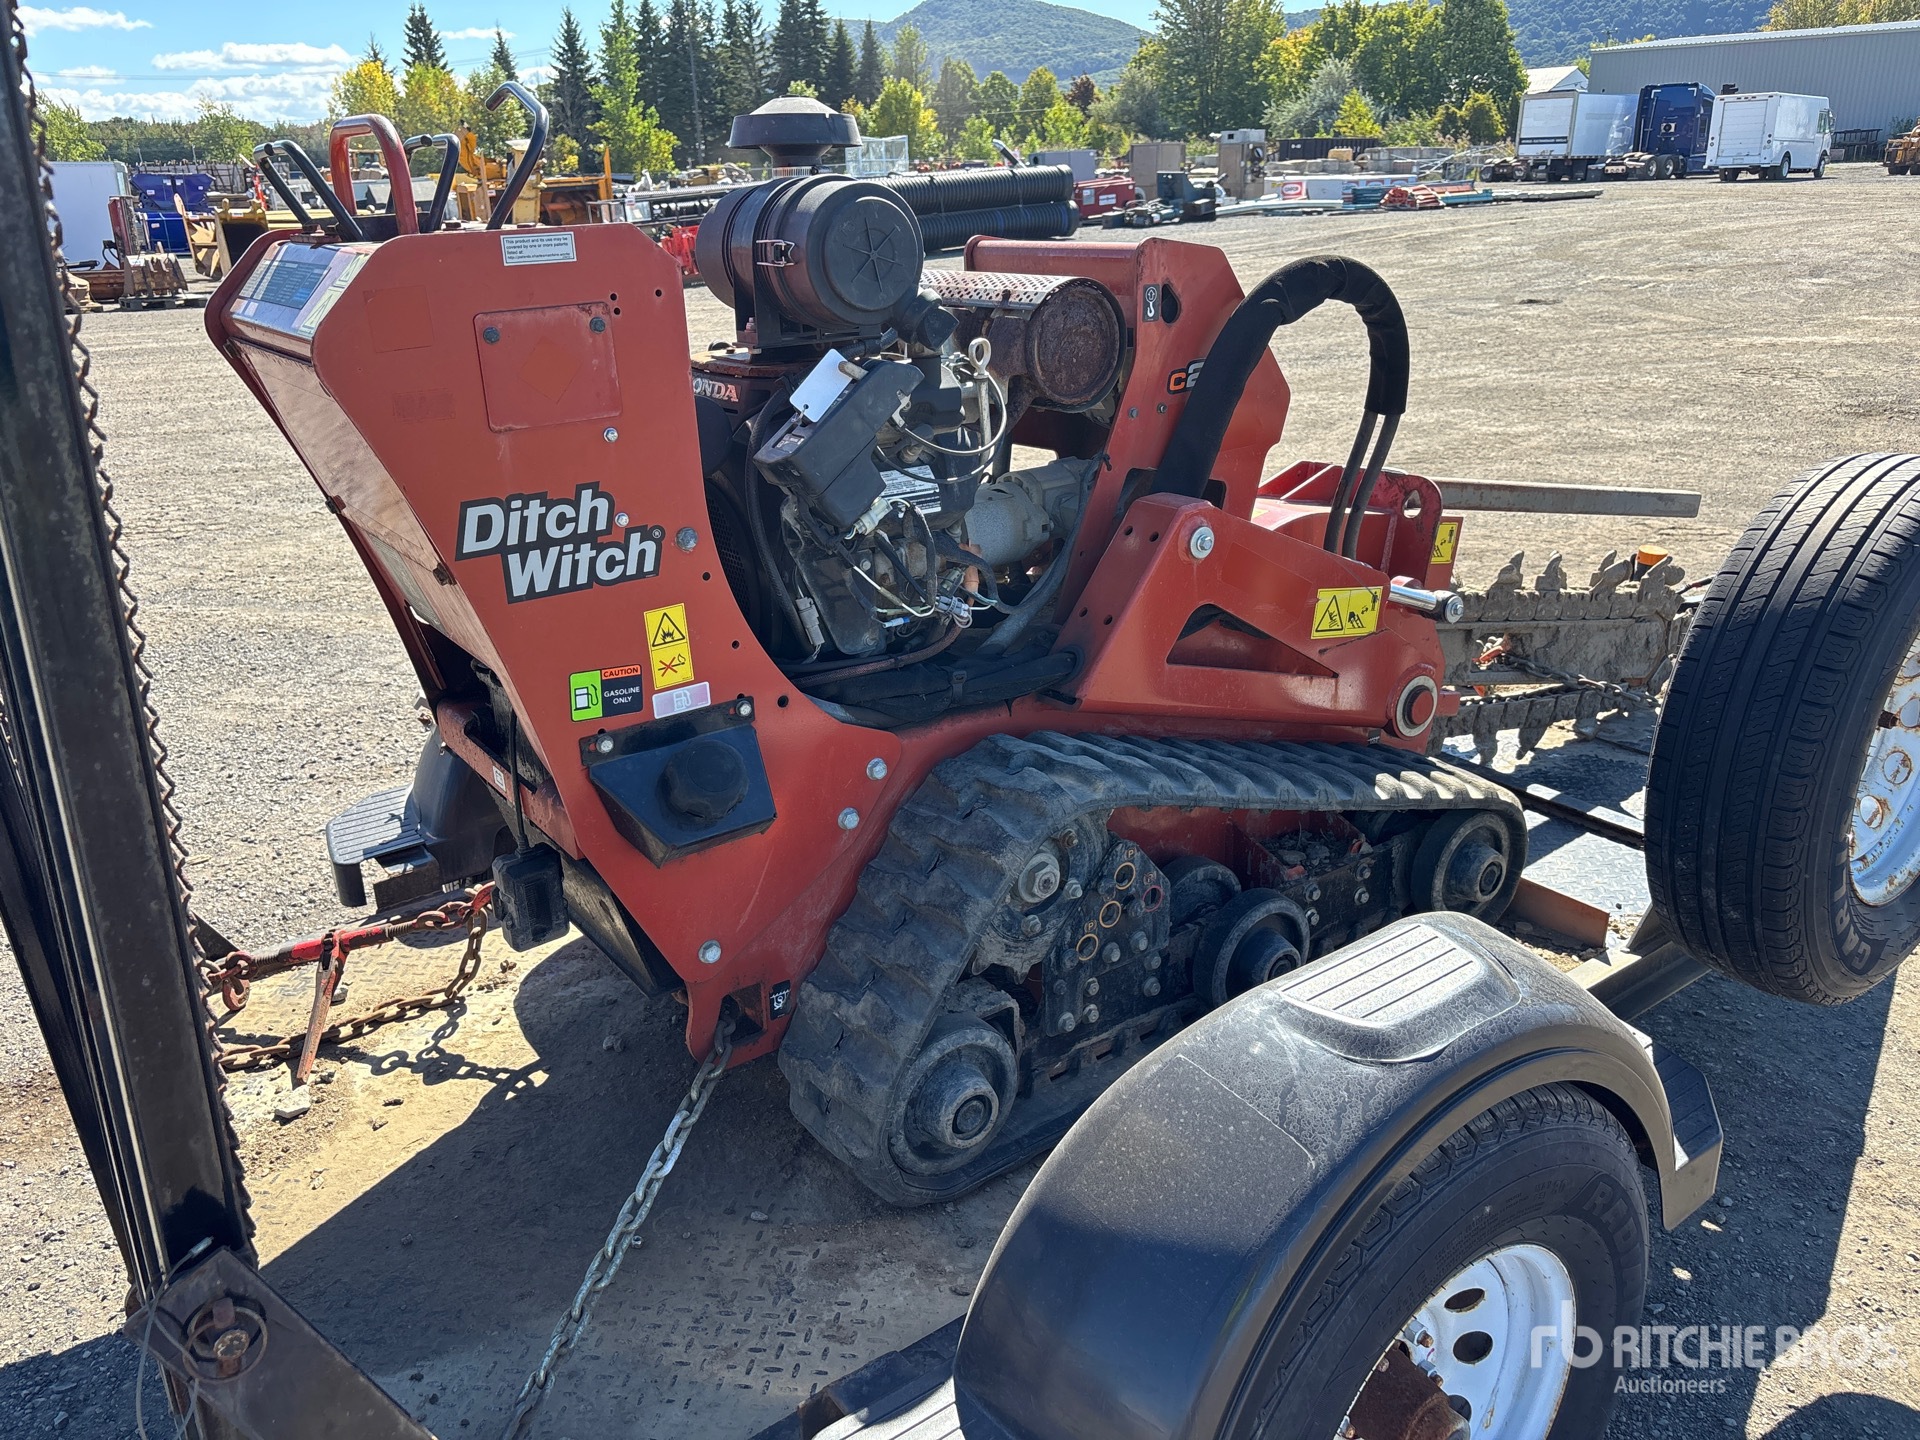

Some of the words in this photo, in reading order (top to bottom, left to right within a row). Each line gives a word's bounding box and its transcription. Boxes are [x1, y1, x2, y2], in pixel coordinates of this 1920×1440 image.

[693, 377, 739, 402] ONDA
[462, 488, 609, 554] Ditch
[507, 532, 657, 597] Witch
[603, 667, 639, 678] CAUTION
[603, 686, 640, 698] GASOLINE
[612, 695, 632, 705] ONLY
